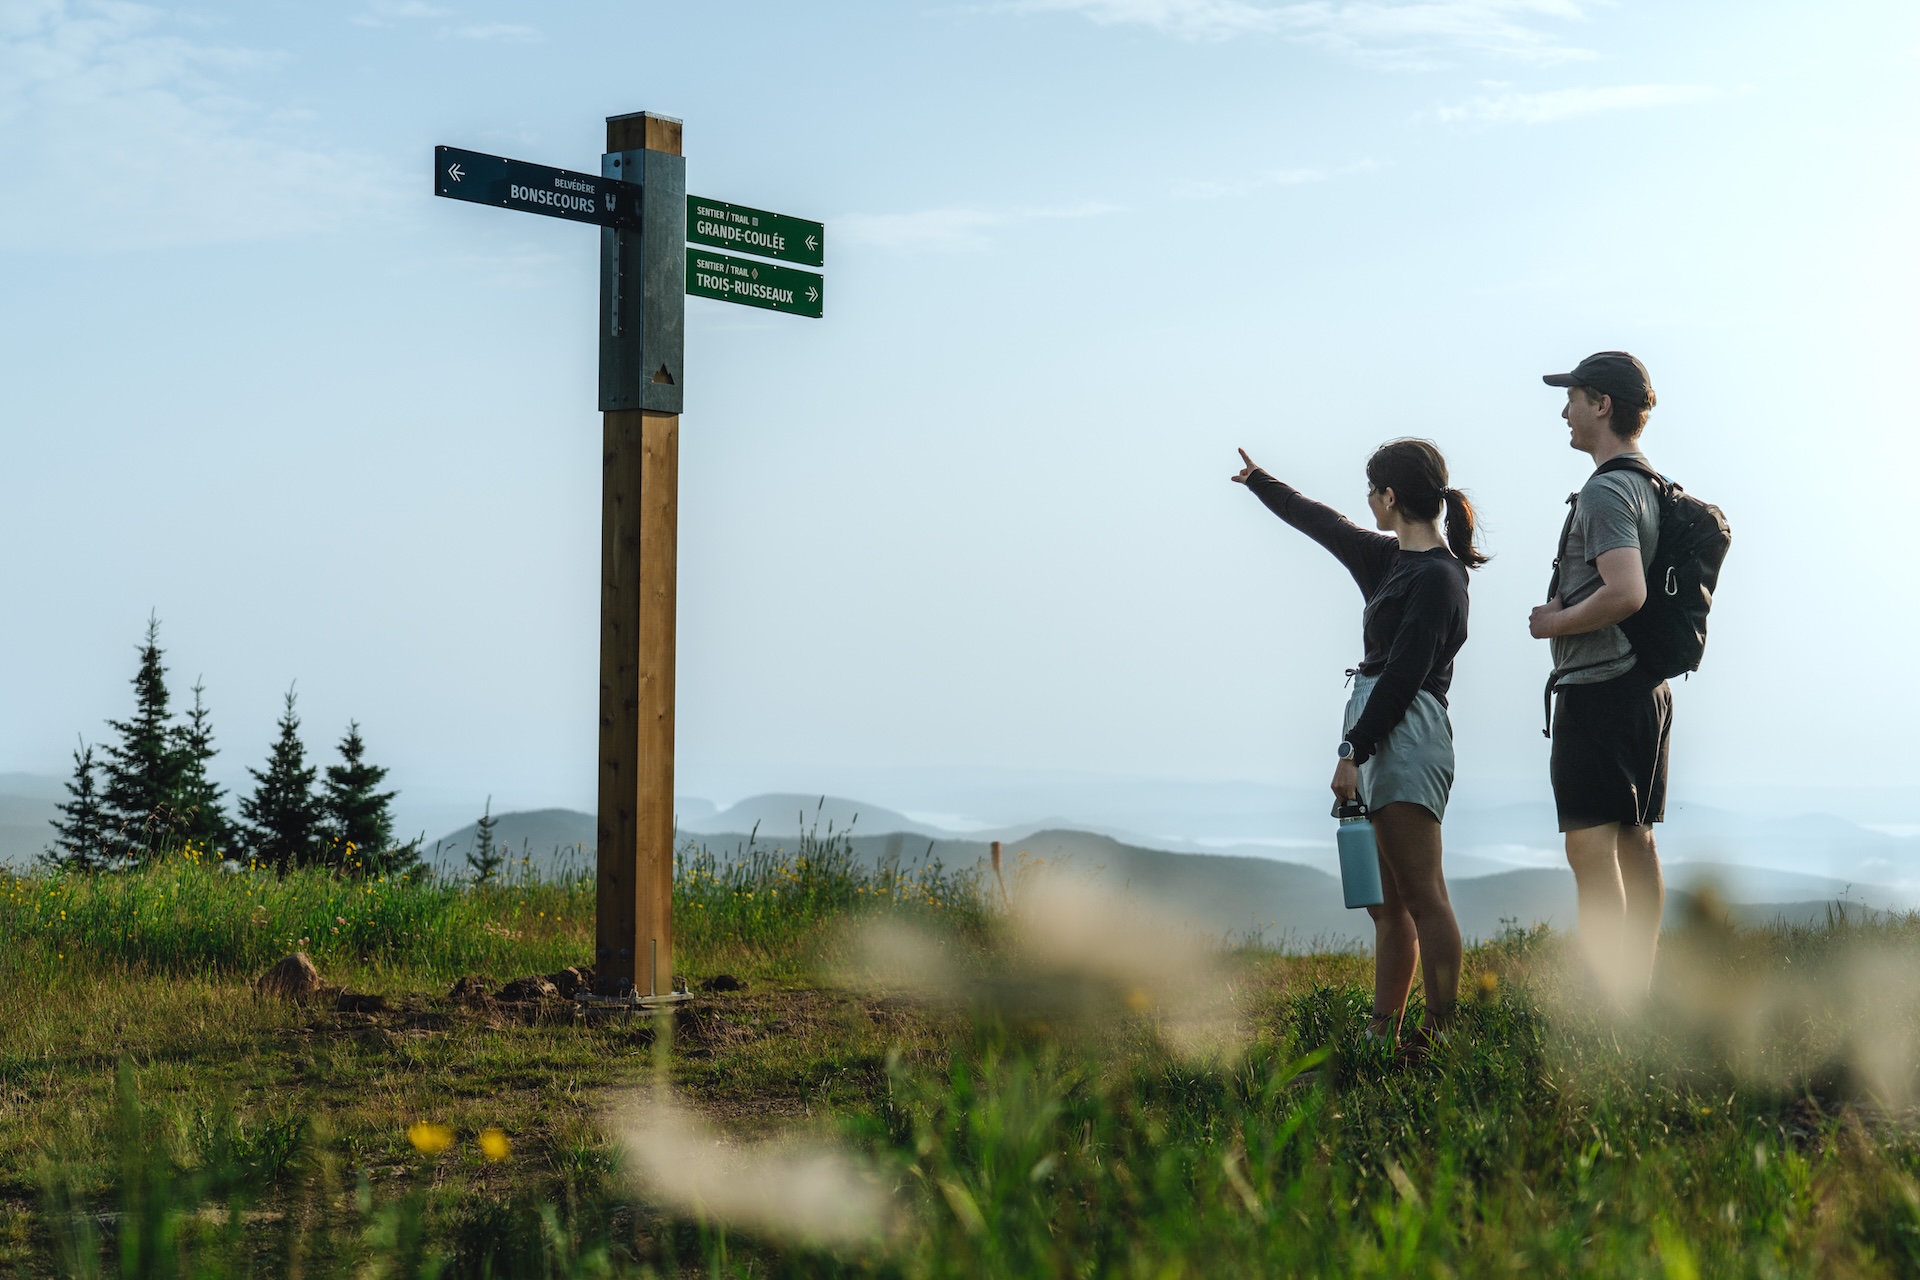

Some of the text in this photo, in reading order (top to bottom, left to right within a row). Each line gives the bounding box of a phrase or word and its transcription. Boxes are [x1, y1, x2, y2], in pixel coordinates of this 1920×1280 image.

[554, 178, 595, 194] BELVÉDÈRE
[511, 184, 595, 213] BONSECOURS
[696, 206, 725, 220] SENTIER
[731, 213, 749, 225] TRAIL
[697, 220, 785, 250] GRANDE-COULÉE
[696, 259, 725, 273] SENTIER
[731, 266, 749, 277] TRAIL
[696, 273, 794, 304] TROIS-RUISSEAUX
